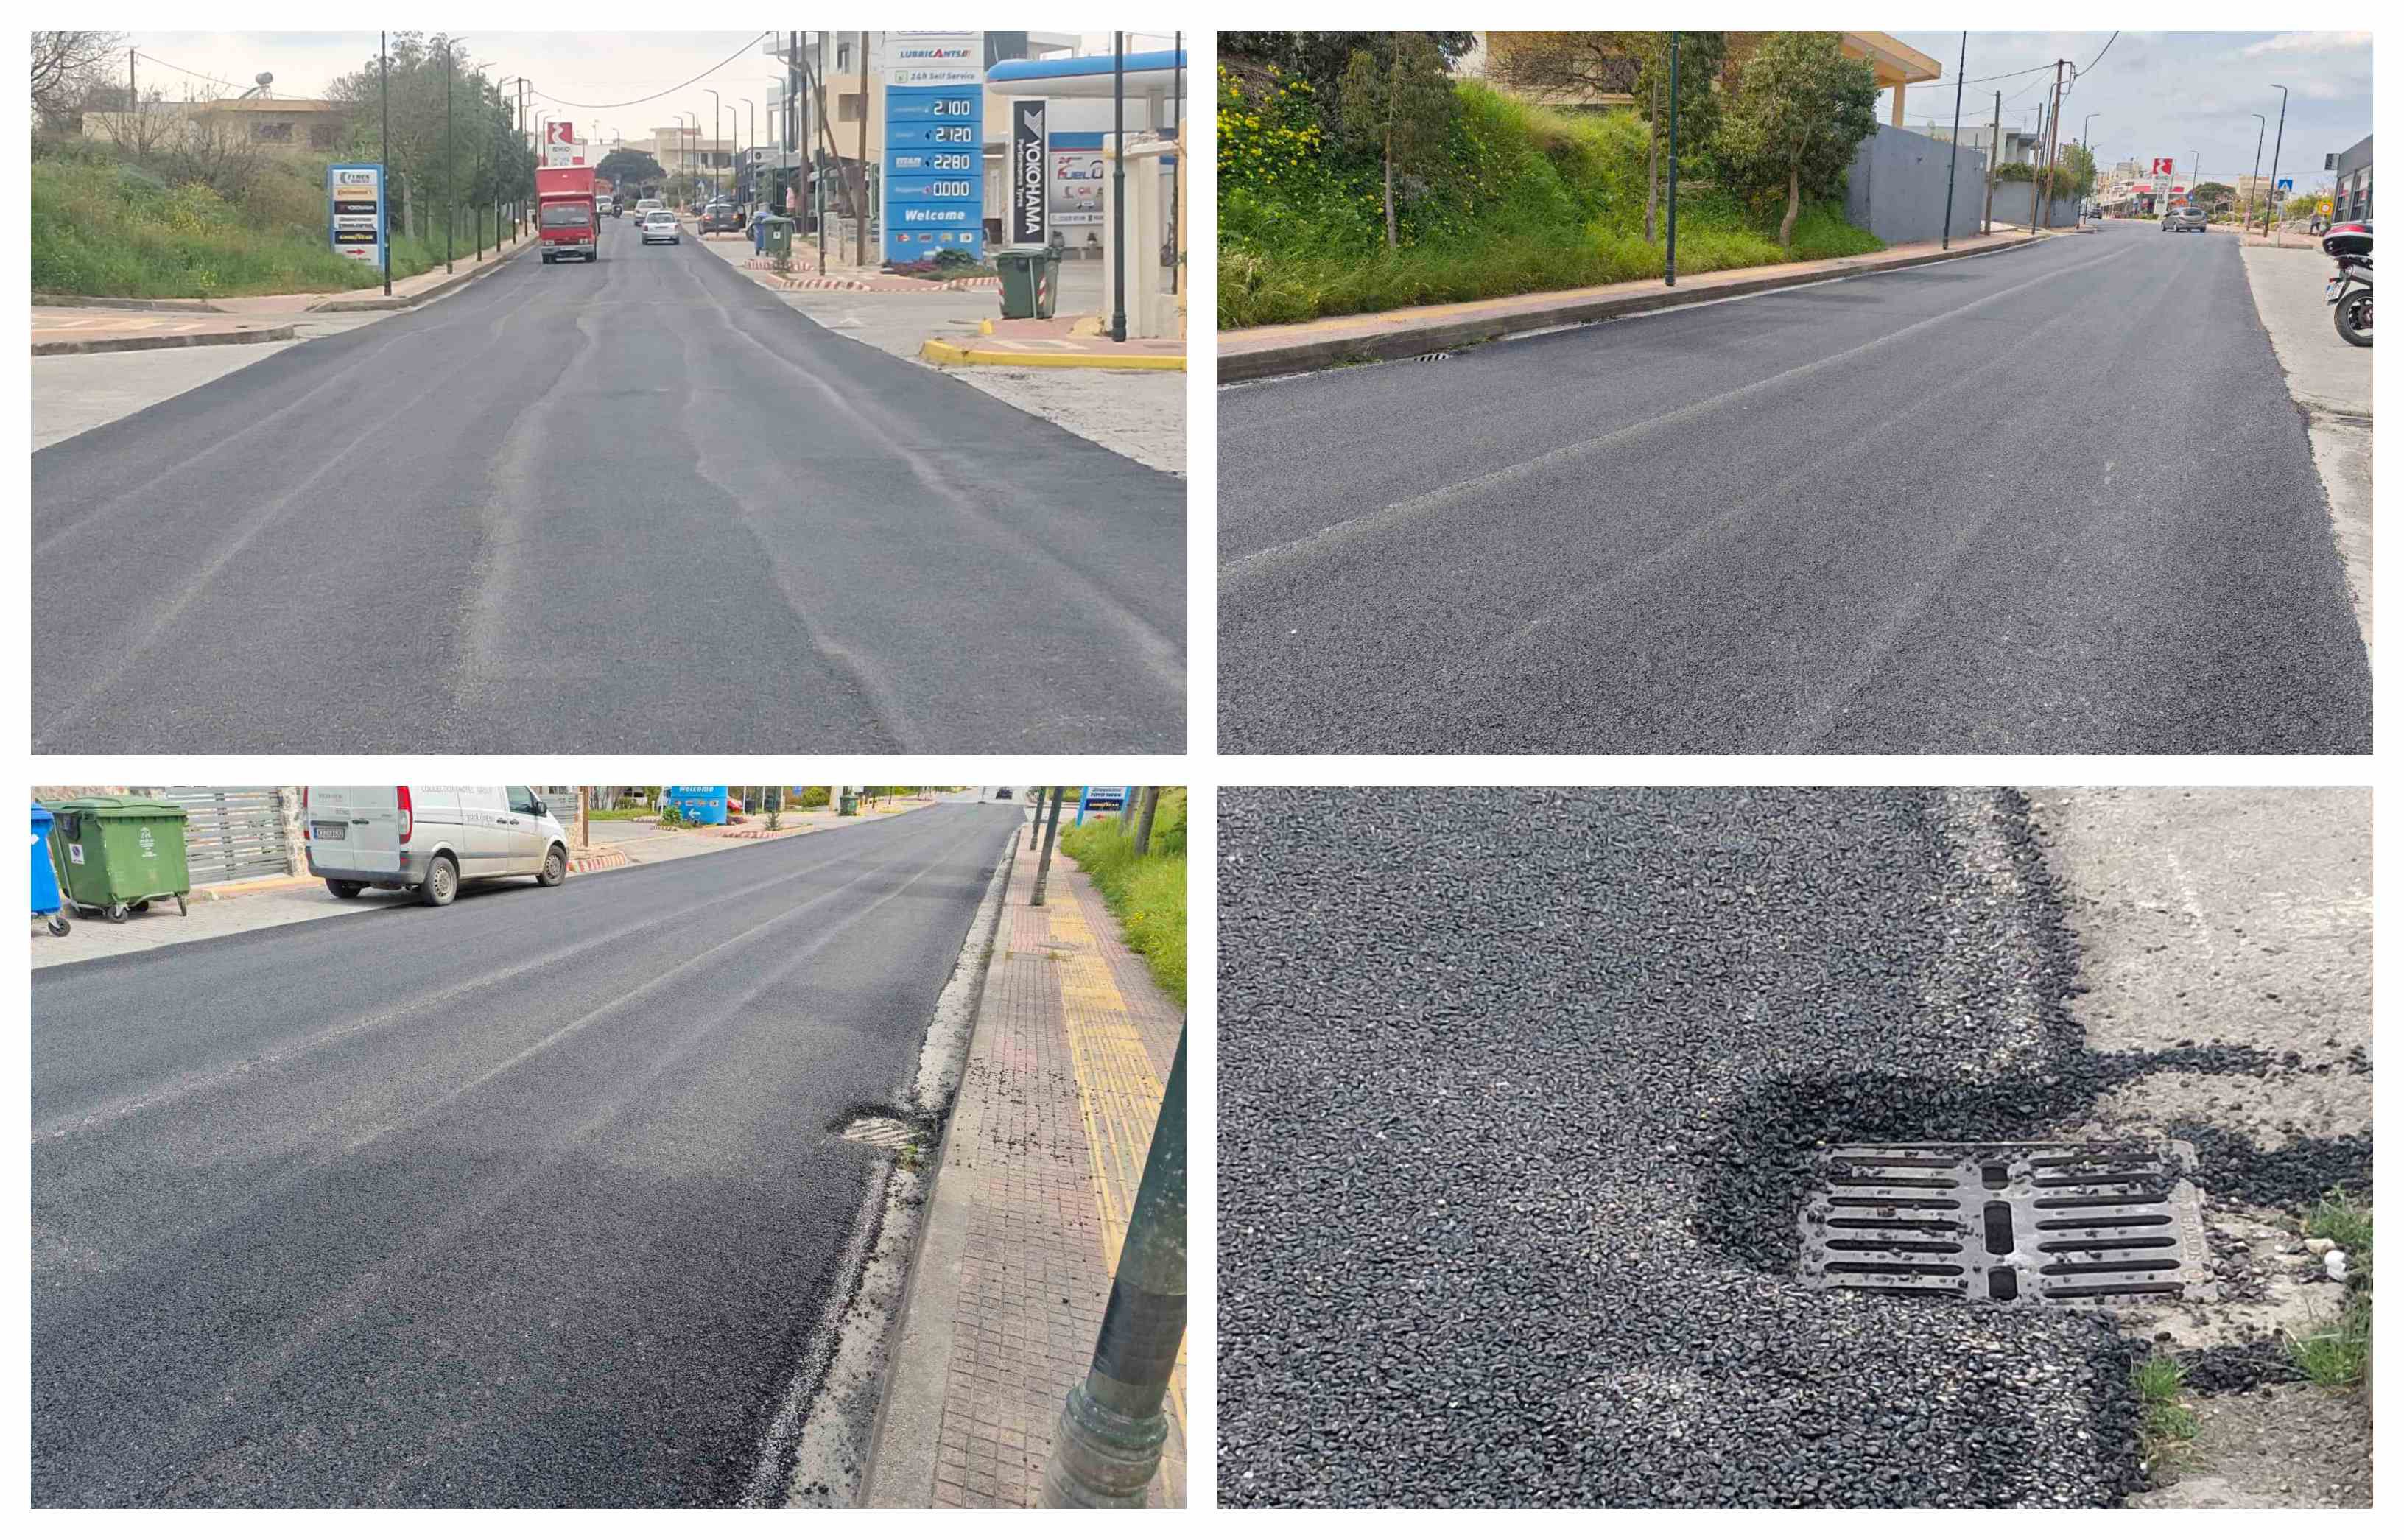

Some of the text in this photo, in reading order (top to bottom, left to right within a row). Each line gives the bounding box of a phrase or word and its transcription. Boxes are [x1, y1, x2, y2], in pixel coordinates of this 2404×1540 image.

[946, 72, 976, 80] Service
[1025, 139, 1041, 235] YOKOHAMA
[905, 209, 966, 222] Welcome
